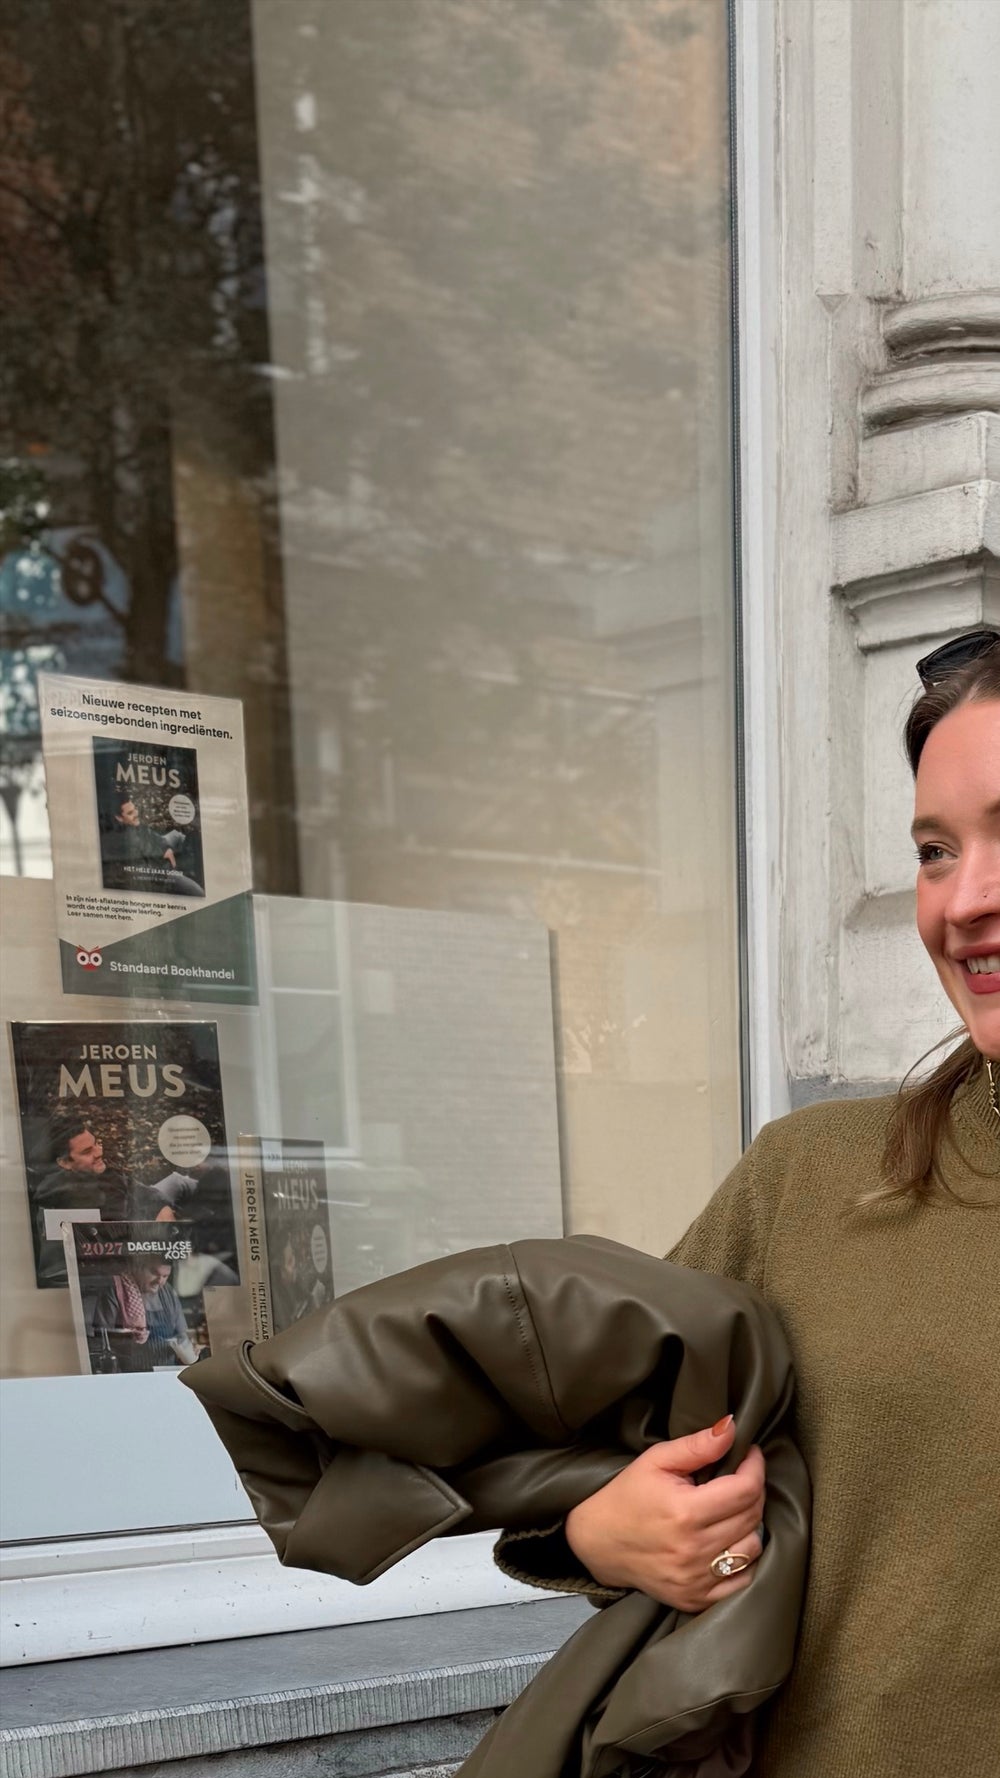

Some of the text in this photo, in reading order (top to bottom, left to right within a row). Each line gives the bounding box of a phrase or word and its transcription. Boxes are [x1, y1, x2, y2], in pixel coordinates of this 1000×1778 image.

[82, 694, 202, 721] Nieuwe recepten met
[50, 706, 234, 740] seizoensgebonden ingrediënten.
[127, 752, 167, 766] JEROEN
[116, 762, 181, 789] MEUS
[110, 961, 235, 979] Standaard Boekhandel
[80, 1044, 157, 1060] JEROEN
[58, 1063, 186, 1098] MEUS
[276, 1178, 319, 1211] MEUS
[245, 1173, 260, 1262] JEROEN MEUS
[83, 1242, 123, 1256] 2027
[127, 1240, 192, 1251] DAGELIJKSE
[164, 1250, 192, 1260] KOST
